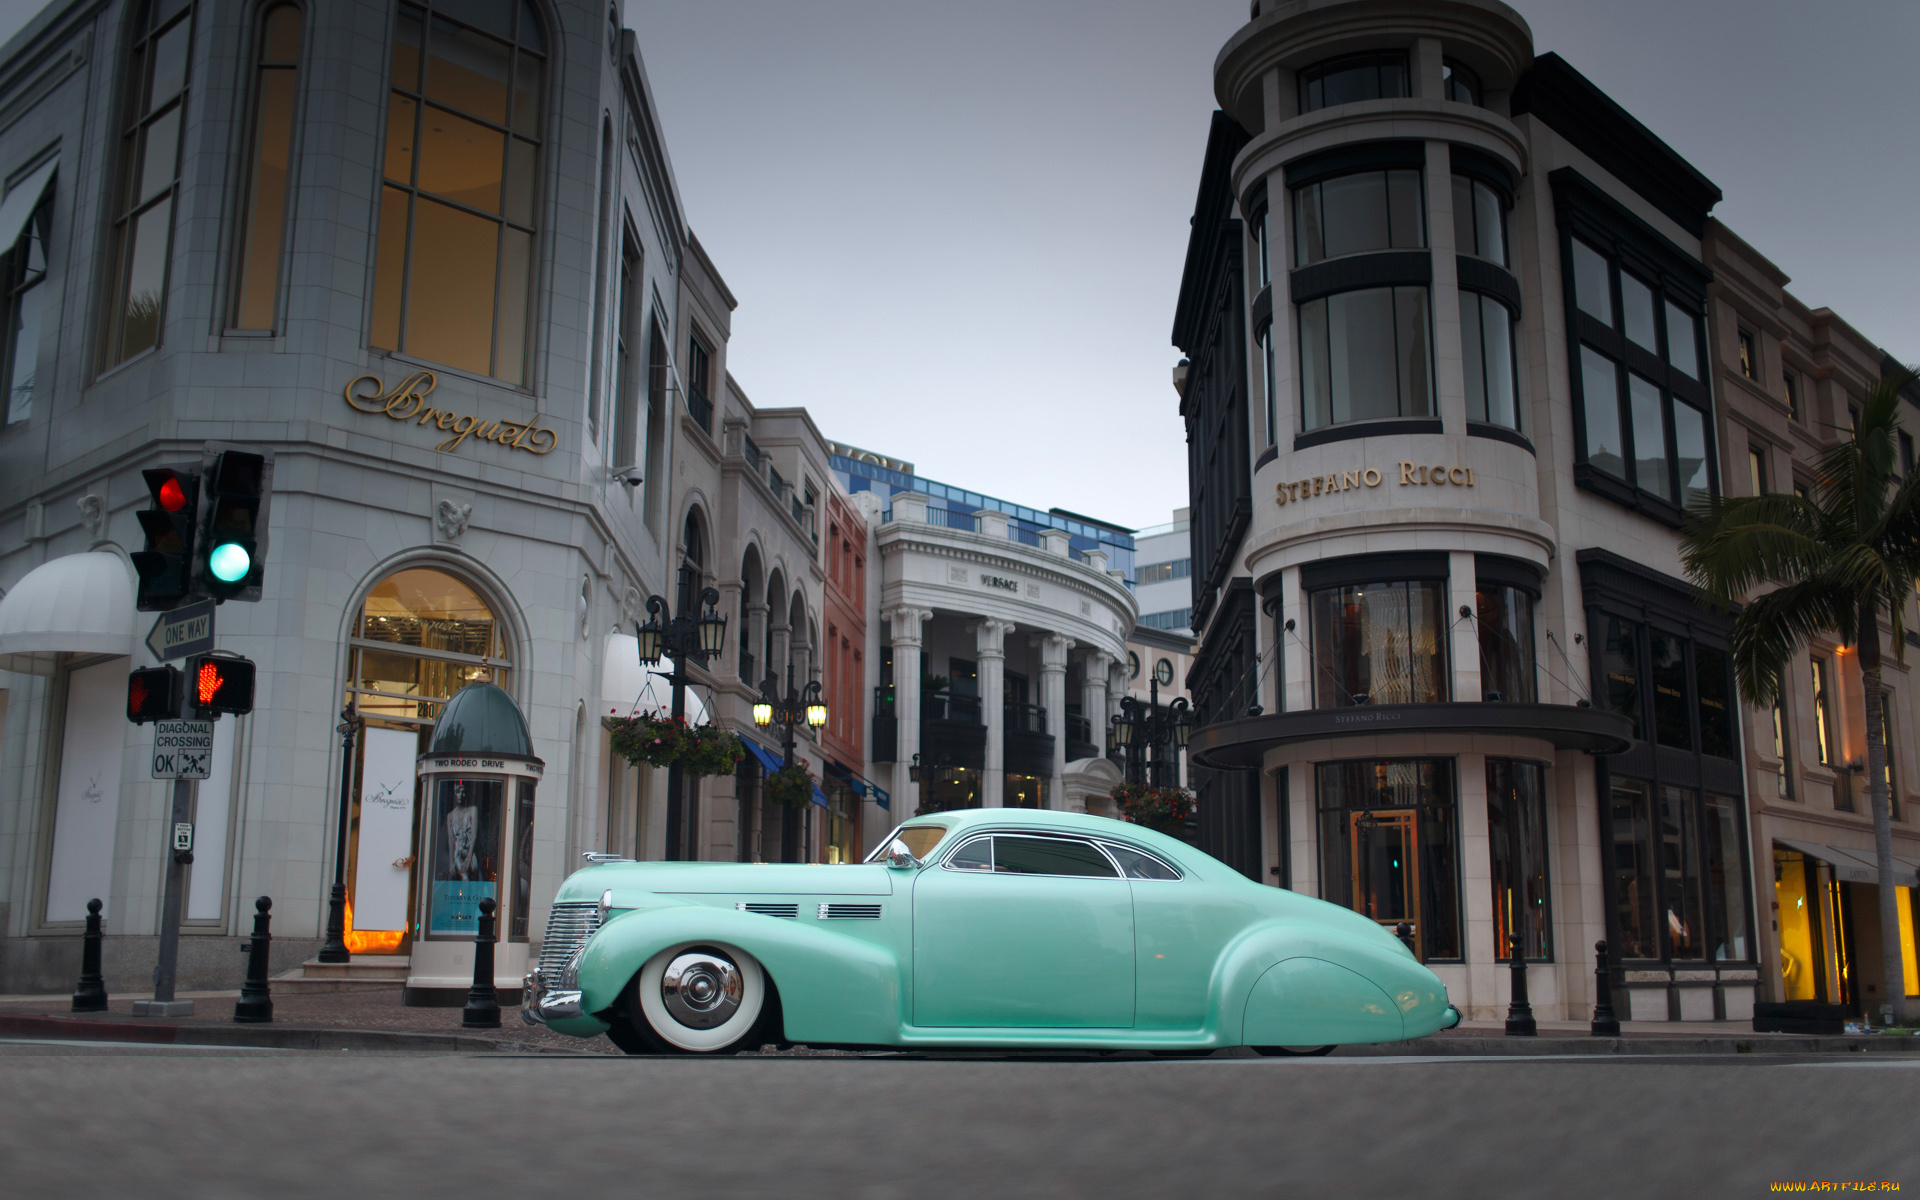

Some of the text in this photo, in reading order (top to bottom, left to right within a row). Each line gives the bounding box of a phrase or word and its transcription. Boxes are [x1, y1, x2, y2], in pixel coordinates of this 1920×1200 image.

[345, 371, 557, 454] Breguet
[1275, 461, 1475, 506] STEFANO RICCI
[980, 574, 1018, 593] VERSACE
[165, 617, 207, 646] ONE WAY
[417, 702, 434, 718] 280
[1335, 712, 1400, 724] STEFANO RICCI
[158, 722, 210, 734] DIAGONAL
[157, 736, 211, 748] CROSSING
[155, 754, 174, 773] OK
[481, 760, 505, 768] DRIVE
[365, 792, 410, 808] Breguet
